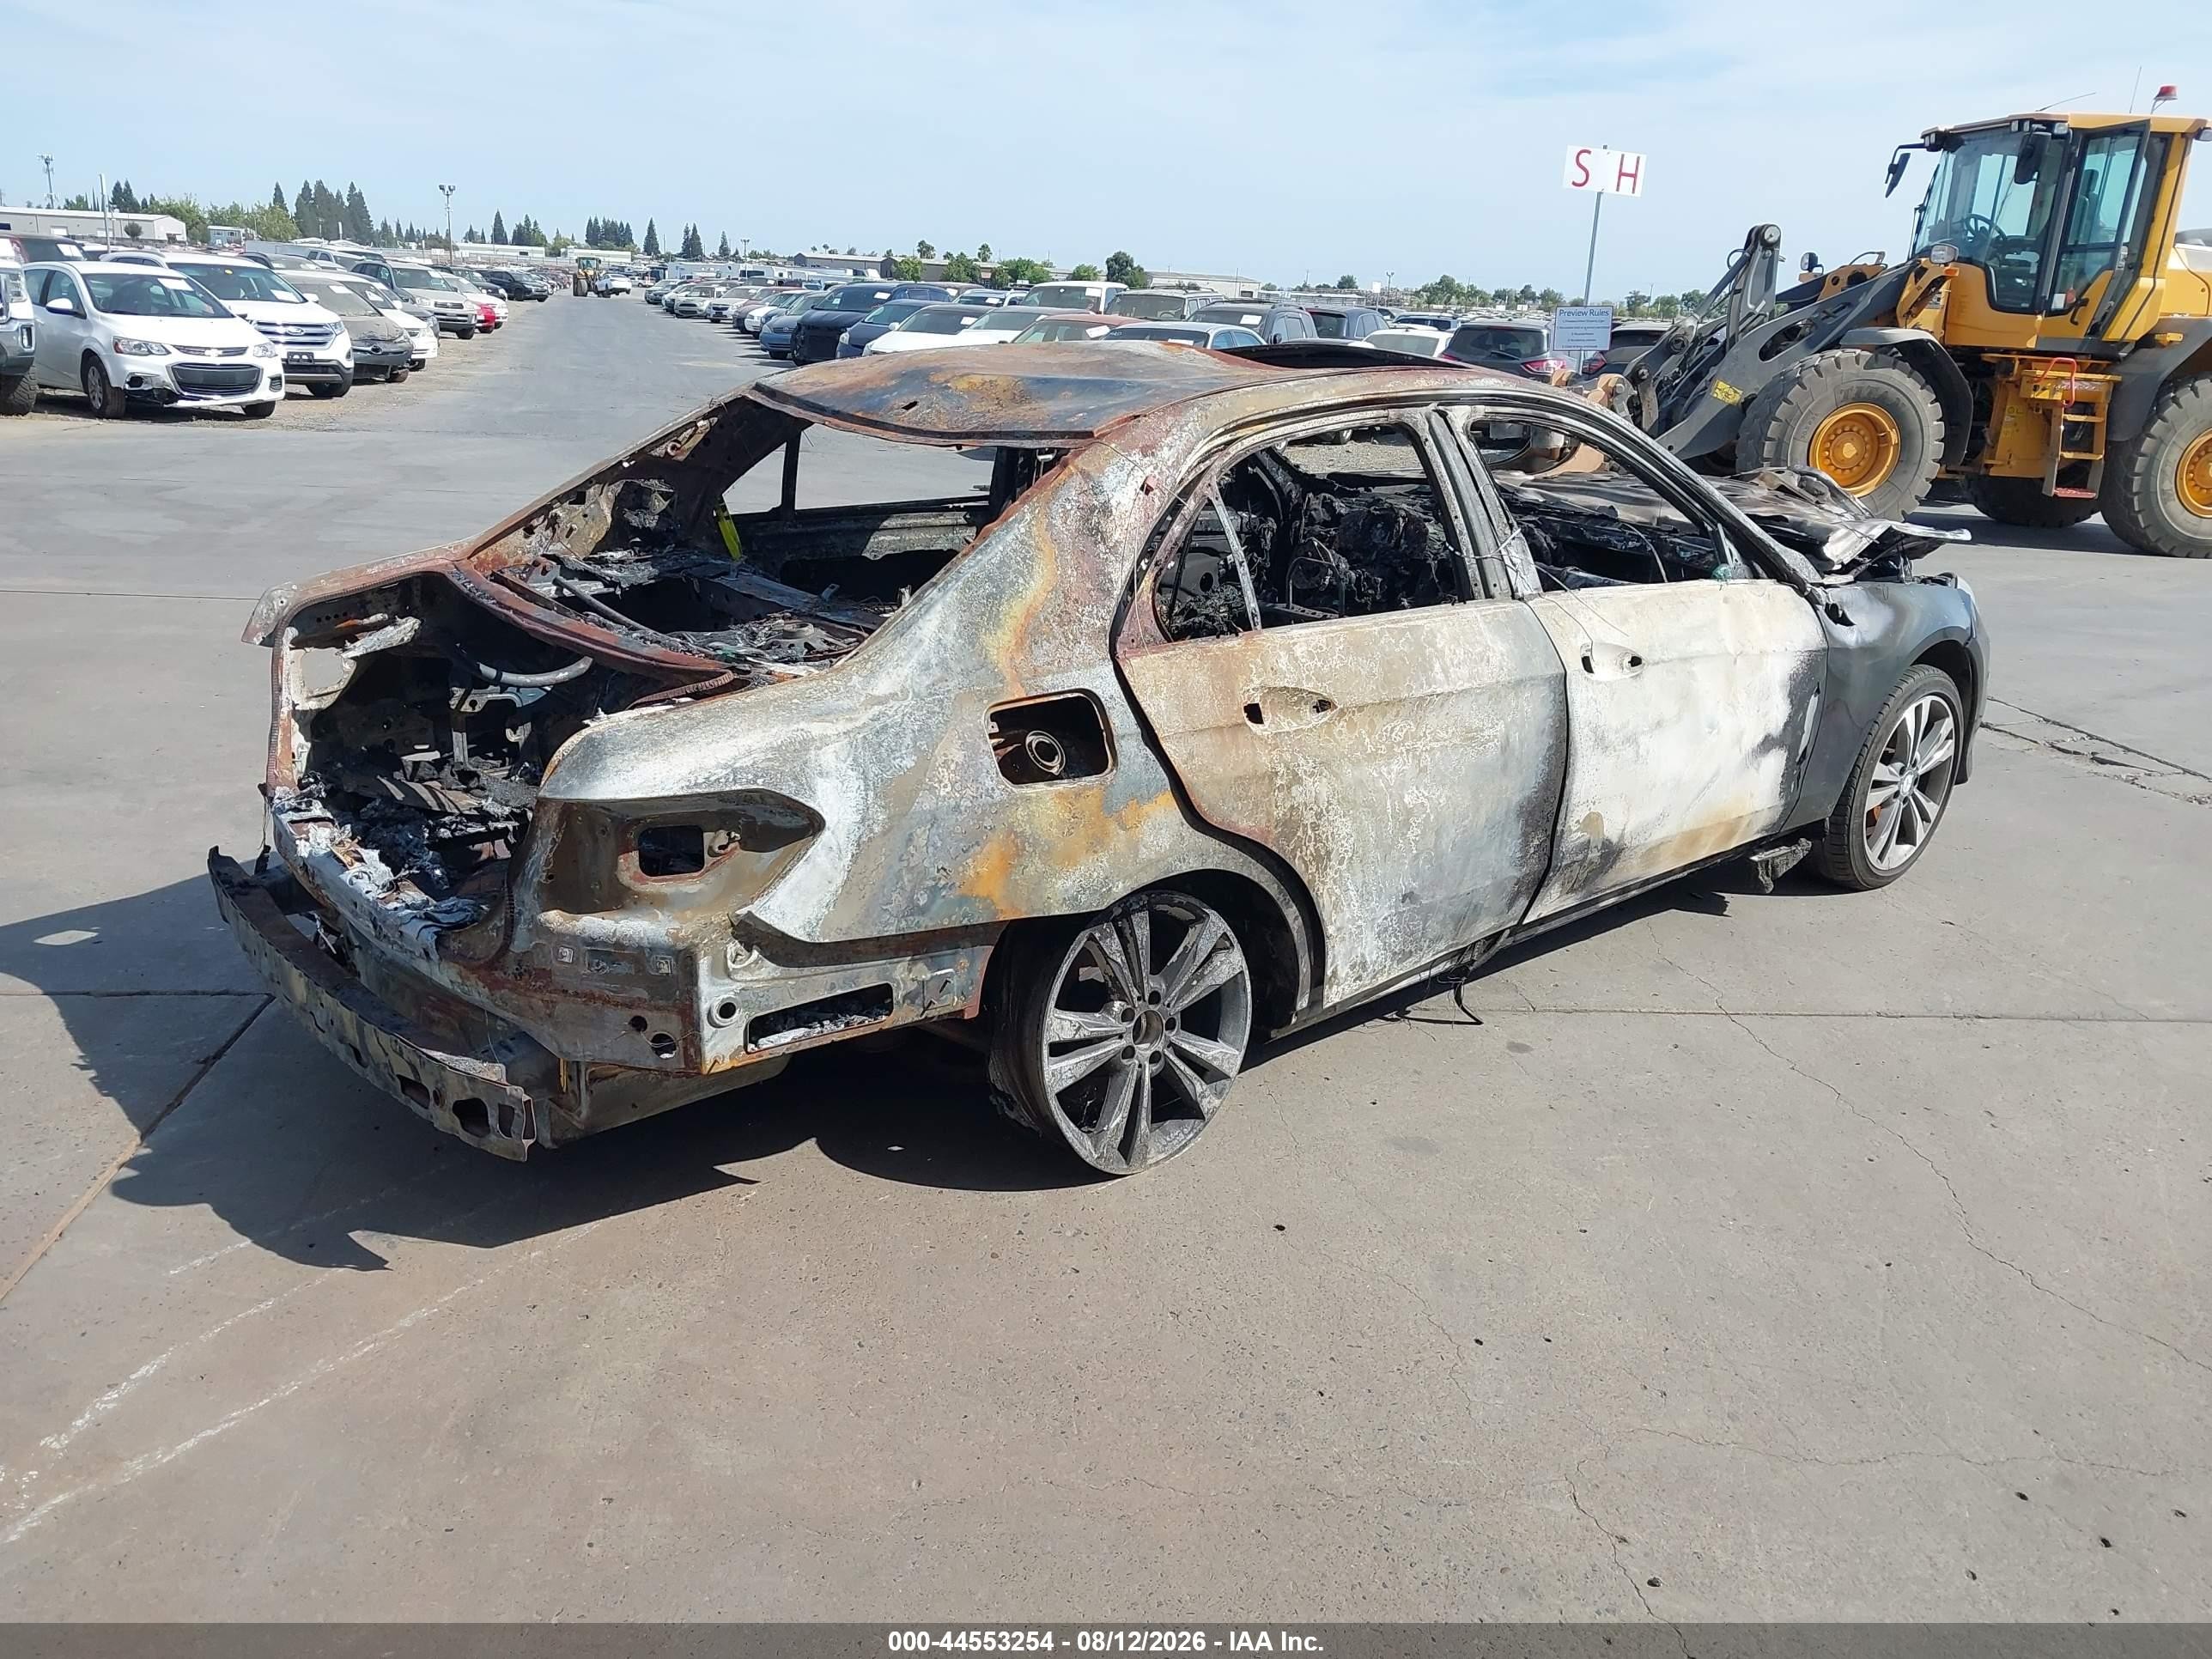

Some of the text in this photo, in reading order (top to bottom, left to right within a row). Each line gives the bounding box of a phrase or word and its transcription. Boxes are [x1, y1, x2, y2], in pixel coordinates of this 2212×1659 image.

[1571, 149, 1641, 194] S H
[1559, 308, 1609, 317] Preview Rules
